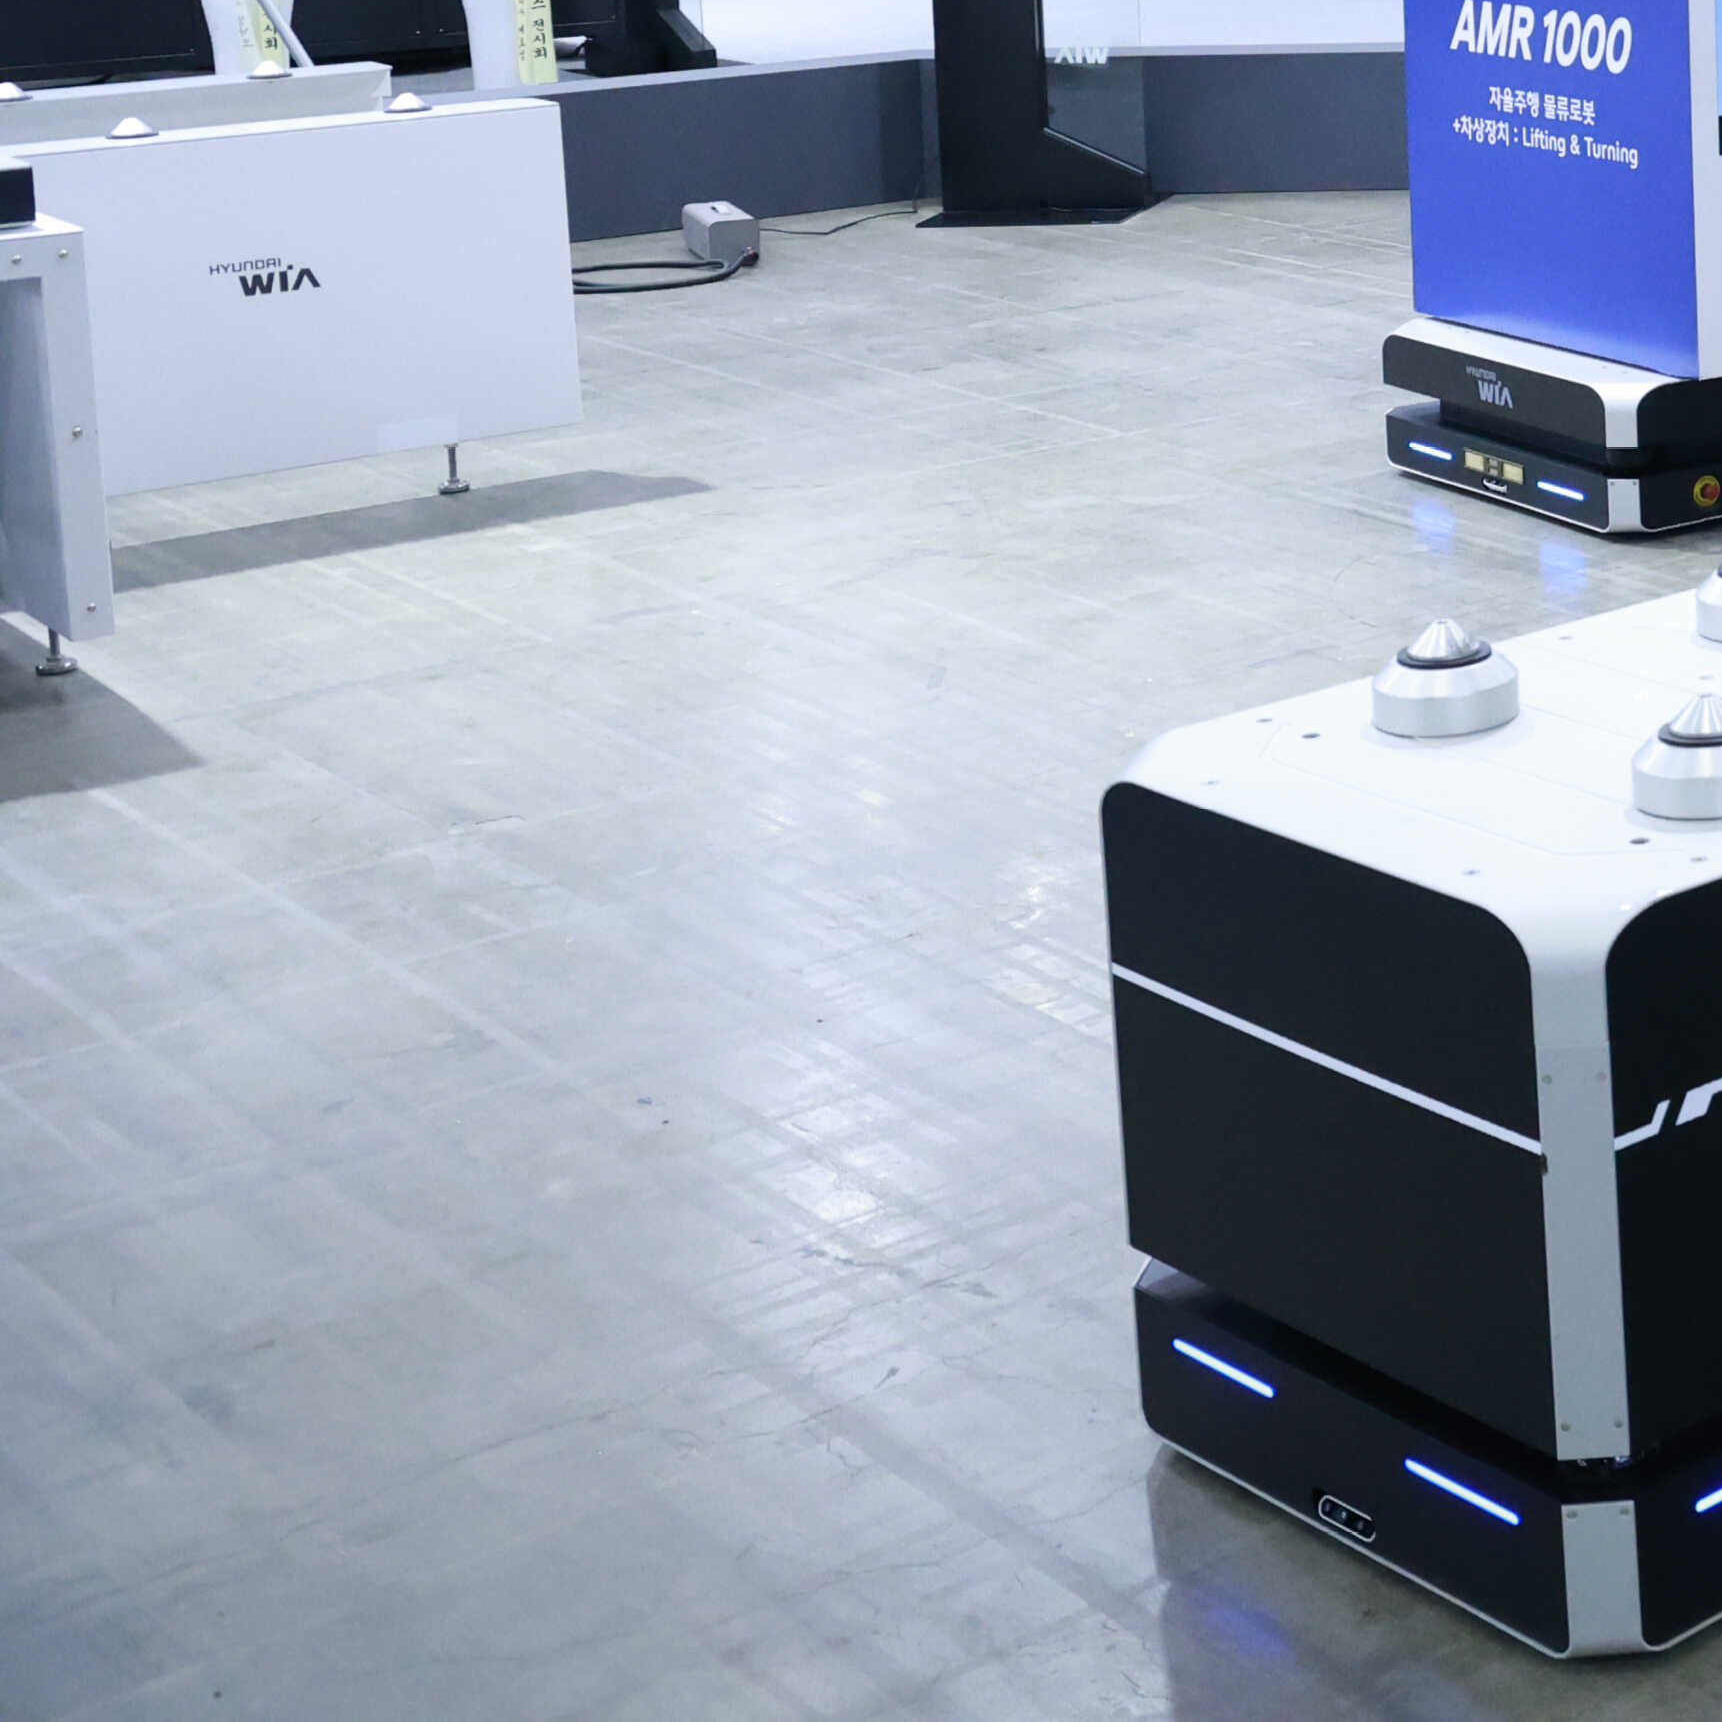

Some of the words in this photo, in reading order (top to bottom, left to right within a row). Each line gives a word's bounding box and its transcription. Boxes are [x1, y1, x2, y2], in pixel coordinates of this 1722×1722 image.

[263, 11, 279, 51] 시회
[1543, 9, 1633, 75] 1000
[1488, 85, 1540, 118] 자율주행
[1543, 93, 1596, 126] 물류로봇
[1522, 126, 1566, 158] Lifting
[1569, 134, 1581, 155] &
[1584, 136, 1640, 170] Turning
[208, 256, 282, 276] HYUNDAI
[238, 263, 322, 297] WIA
[1478, 380, 1513, 410] WIA
